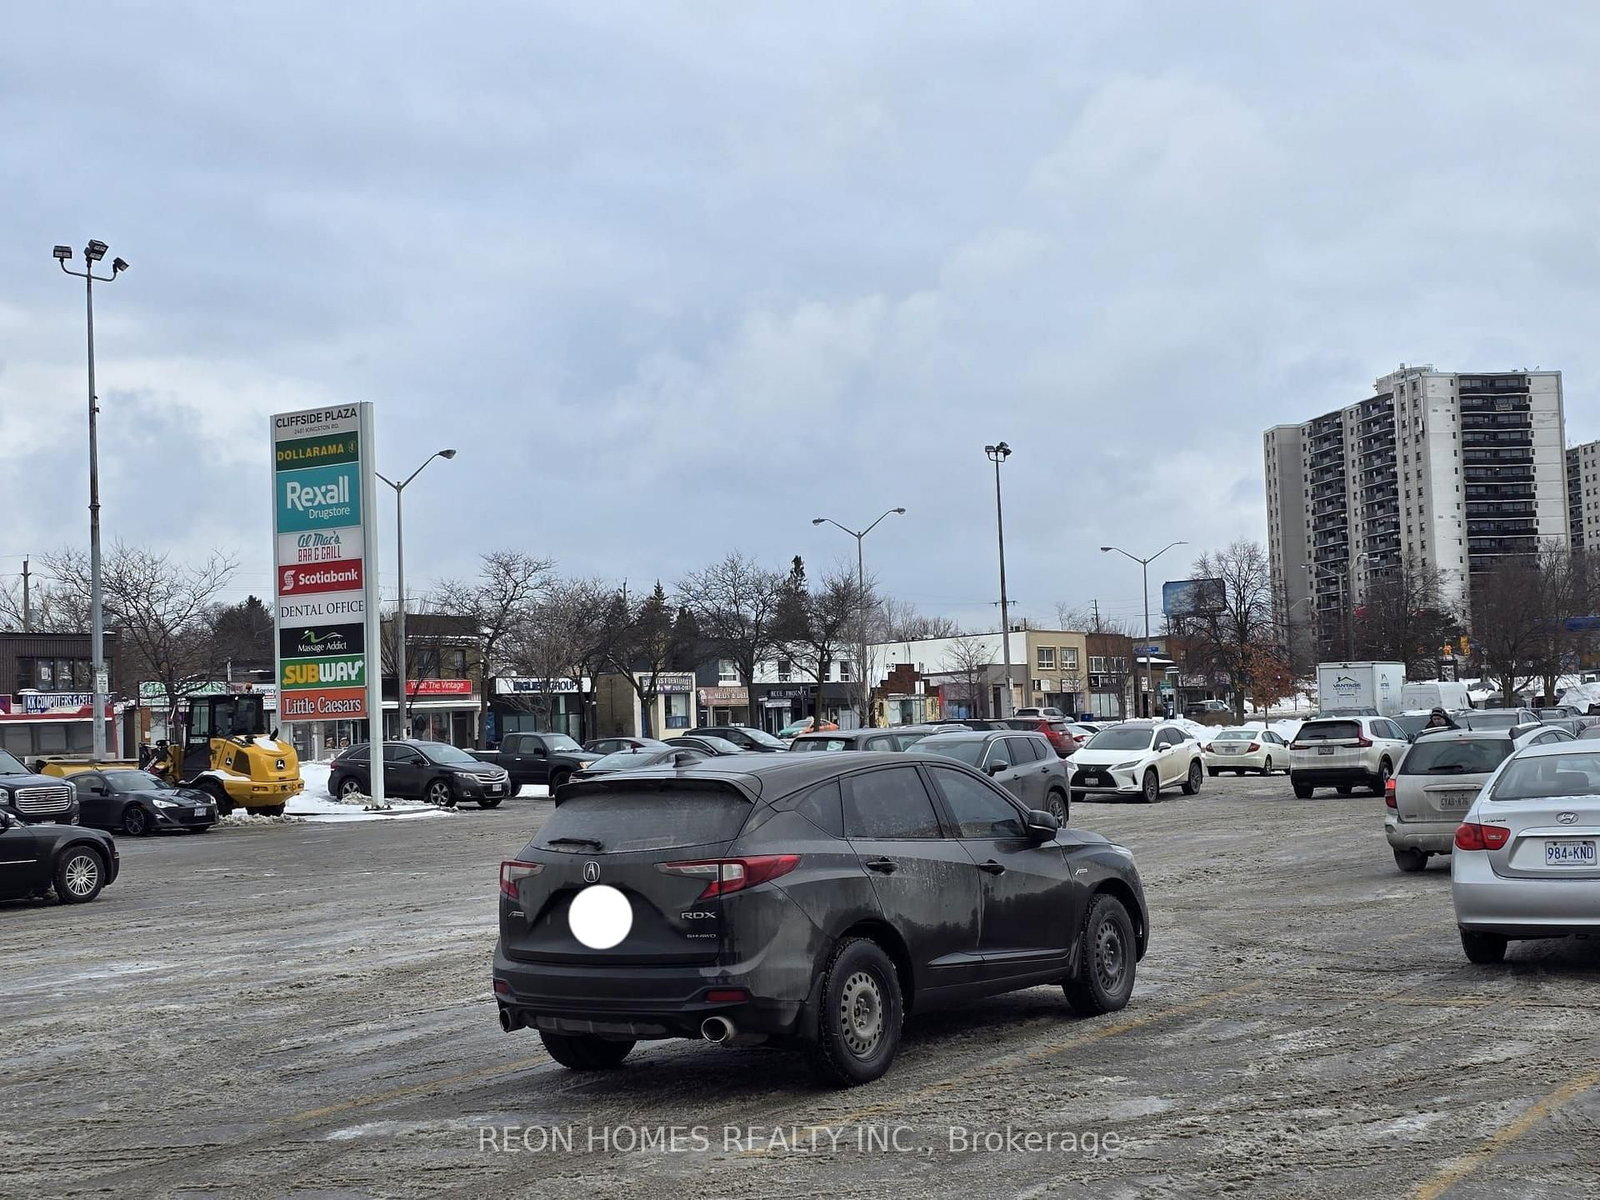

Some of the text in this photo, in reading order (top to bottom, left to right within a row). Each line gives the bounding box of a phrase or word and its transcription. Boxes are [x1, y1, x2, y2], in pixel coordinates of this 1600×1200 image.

[276, 407, 357, 428] CLIFFSIDE PLAZA
[305, 425, 330, 433] KINGSTON
[277, 443, 345, 461] DOLLARAMA
[286, 475, 349, 511] Rexall
[309, 506, 351, 520] Drugstore
[298, 530, 342, 548] Al Mac's
[298, 547, 312, 561] BAR
[321, 545, 342, 560] GRILL
[298, 568, 358, 585] Scotiabank
[281, 600, 364, 618] DENTAL OFFICE
[298, 640, 347, 653] Massage Addict
[282, 660, 365, 685] SUBWAY
[255, 686, 276, 695] Agency
[411, 681, 427, 689] Wat
[429, 681, 440, 689] The
[441, 681, 465, 691] Vintage
[27, 695, 36, 709] KK
[37, 694, 72, 709] COMPUTERS
[285, 697, 315, 715] Little
[317, 696, 361, 714] Caesars
[681, 911, 717, 919] RDX
